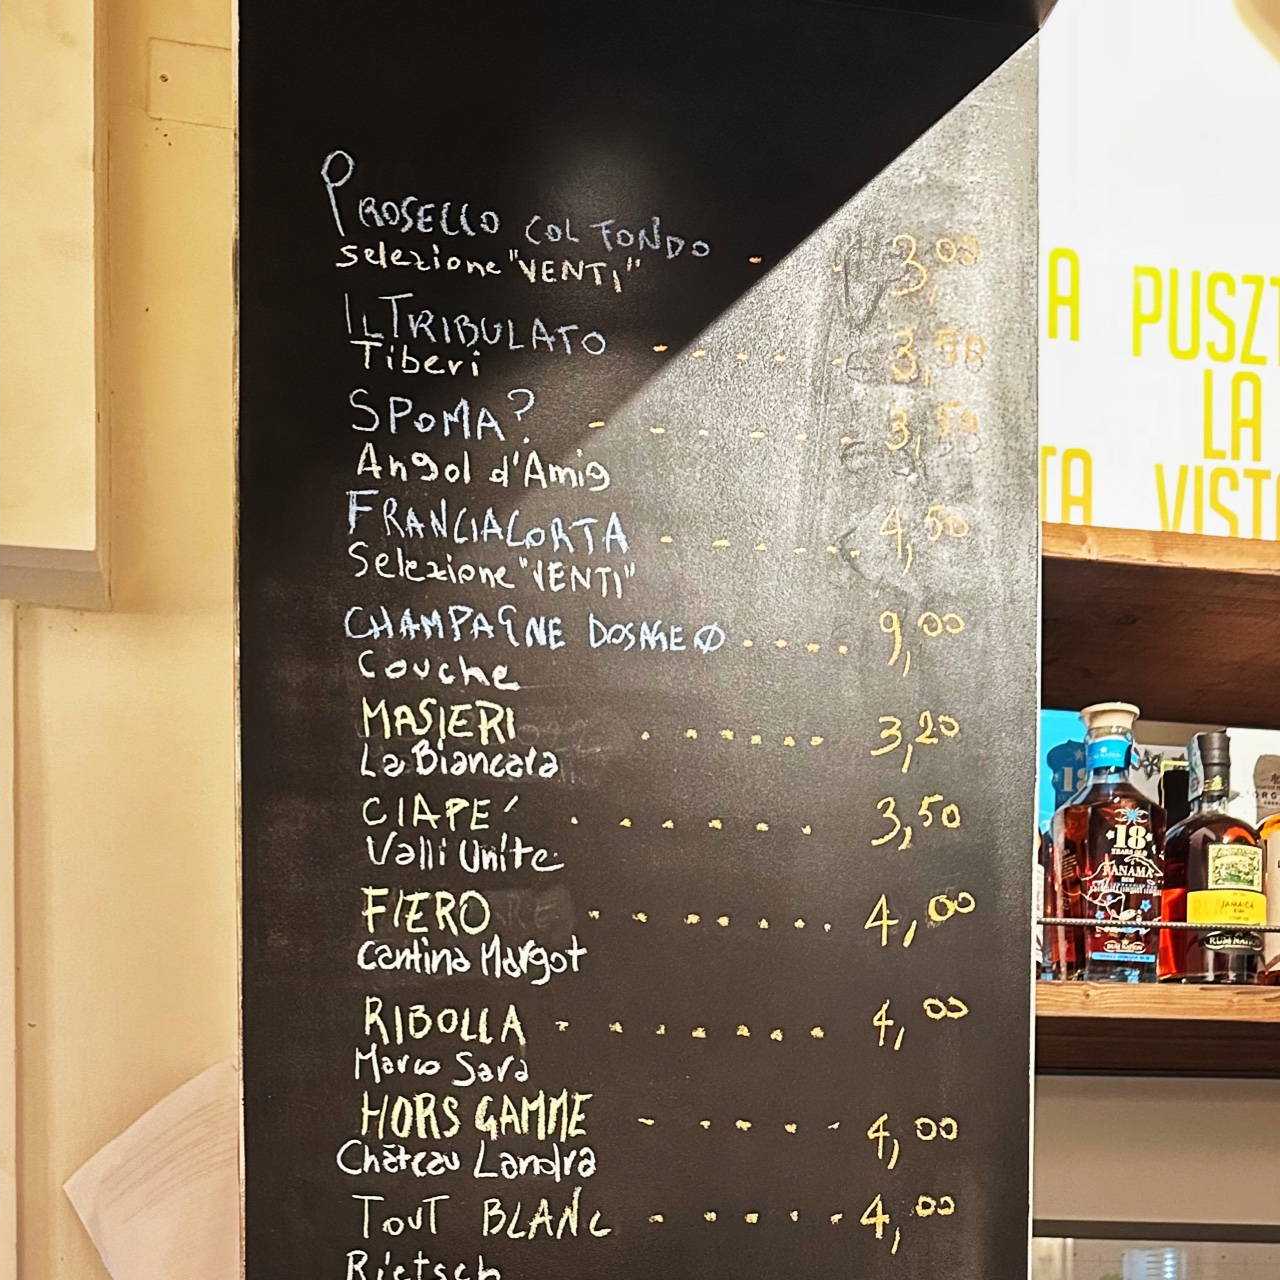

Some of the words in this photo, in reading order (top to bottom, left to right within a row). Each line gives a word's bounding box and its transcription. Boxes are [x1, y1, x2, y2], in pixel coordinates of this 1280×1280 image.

[320, 149, 501, 238] PROSECCO
[525, 215, 581, 246] COL
[590, 216, 711, 260] FONDO
[335, 240, 503, 277] selezione
[1048, 247, 1080, 342] A
[378, 292, 607, 356] TRIBULATO
[350, 340, 481, 377] Tiberi
[1203, 368, 1262, 462] LA
[356, 442, 472, 485] Angol
[346, 488, 630, 556] FRANCIACORTA
[1155, 463, 1280, 541] VIST
[348, 540, 516, 590] Selezione
[343, 604, 567, 651] CHAMPAGNE
[358, 649, 521, 691] Couche
[360, 696, 517, 747] MASIERI
[360, 742, 405, 778] La
[411, 738, 559, 780] Biancara
[871, 794, 961, 850] 3,50
[1113, 825, 1147, 849] 18
[365, 831, 448, 871] Valli
[459, 832, 565, 873] Unite
[361, 885, 492, 937] FIERO
[356, 937, 471, 976] Cantina
[481, 933, 588, 986] Margot
[363, 995, 527, 1046] RIBOLLA
[353, 1042, 441, 1085] Marco
[451, 1051, 529, 1087] Sara
[361, 1089, 462, 1140] HORS
[475, 1088, 593, 1143] GAMME
[473, 1139, 597, 1183] Landra
[351, 1194, 450, 1239] TOUT
[482, 1186, 612, 1240] BLANC
